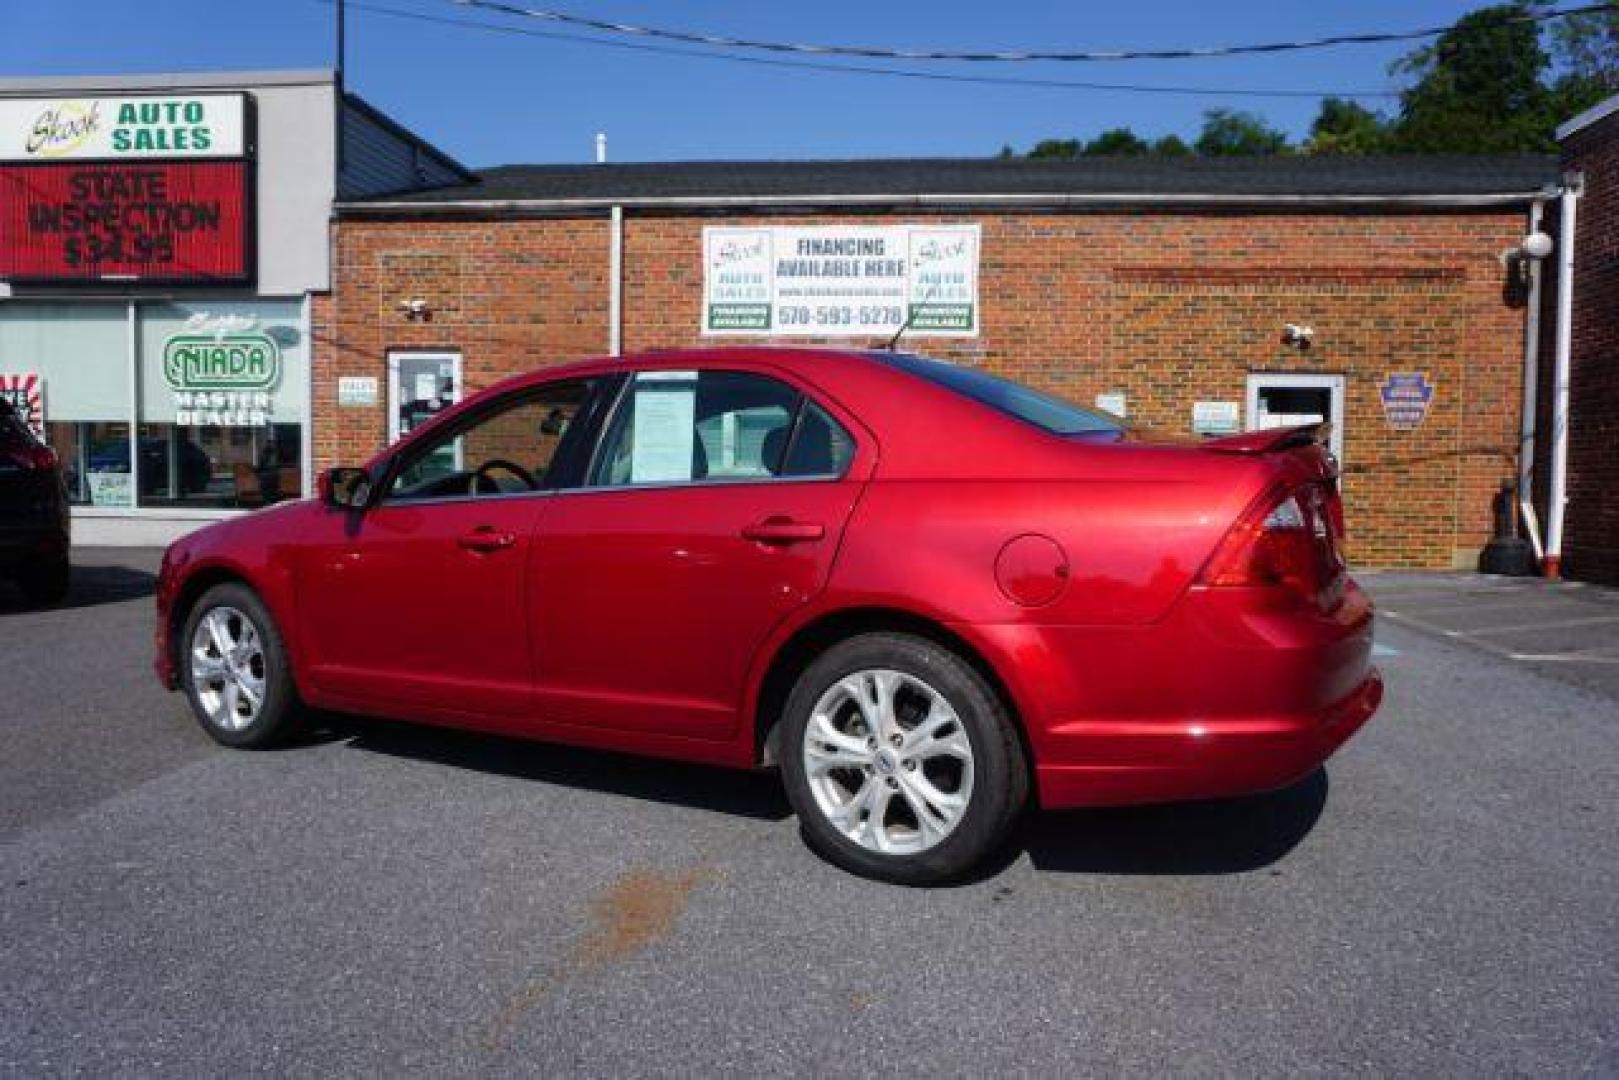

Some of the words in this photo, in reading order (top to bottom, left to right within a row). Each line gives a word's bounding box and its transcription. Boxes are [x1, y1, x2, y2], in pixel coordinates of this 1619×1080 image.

[118, 101, 204, 125] AUTO
[113, 127, 211, 152] SALES
[69, 171, 167, 200] STATE
[28, 201, 220, 232] INSPECTION
[796, 237, 885, 255] FINANCING
[776, 258, 859, 278] AVAILABLE
[864, 258, 905, 278] HERE
[173, 348, 264, 377] NIADA
[176, 392, 271, 409] MASTER
[176, 410, 268, 425] DEALER
